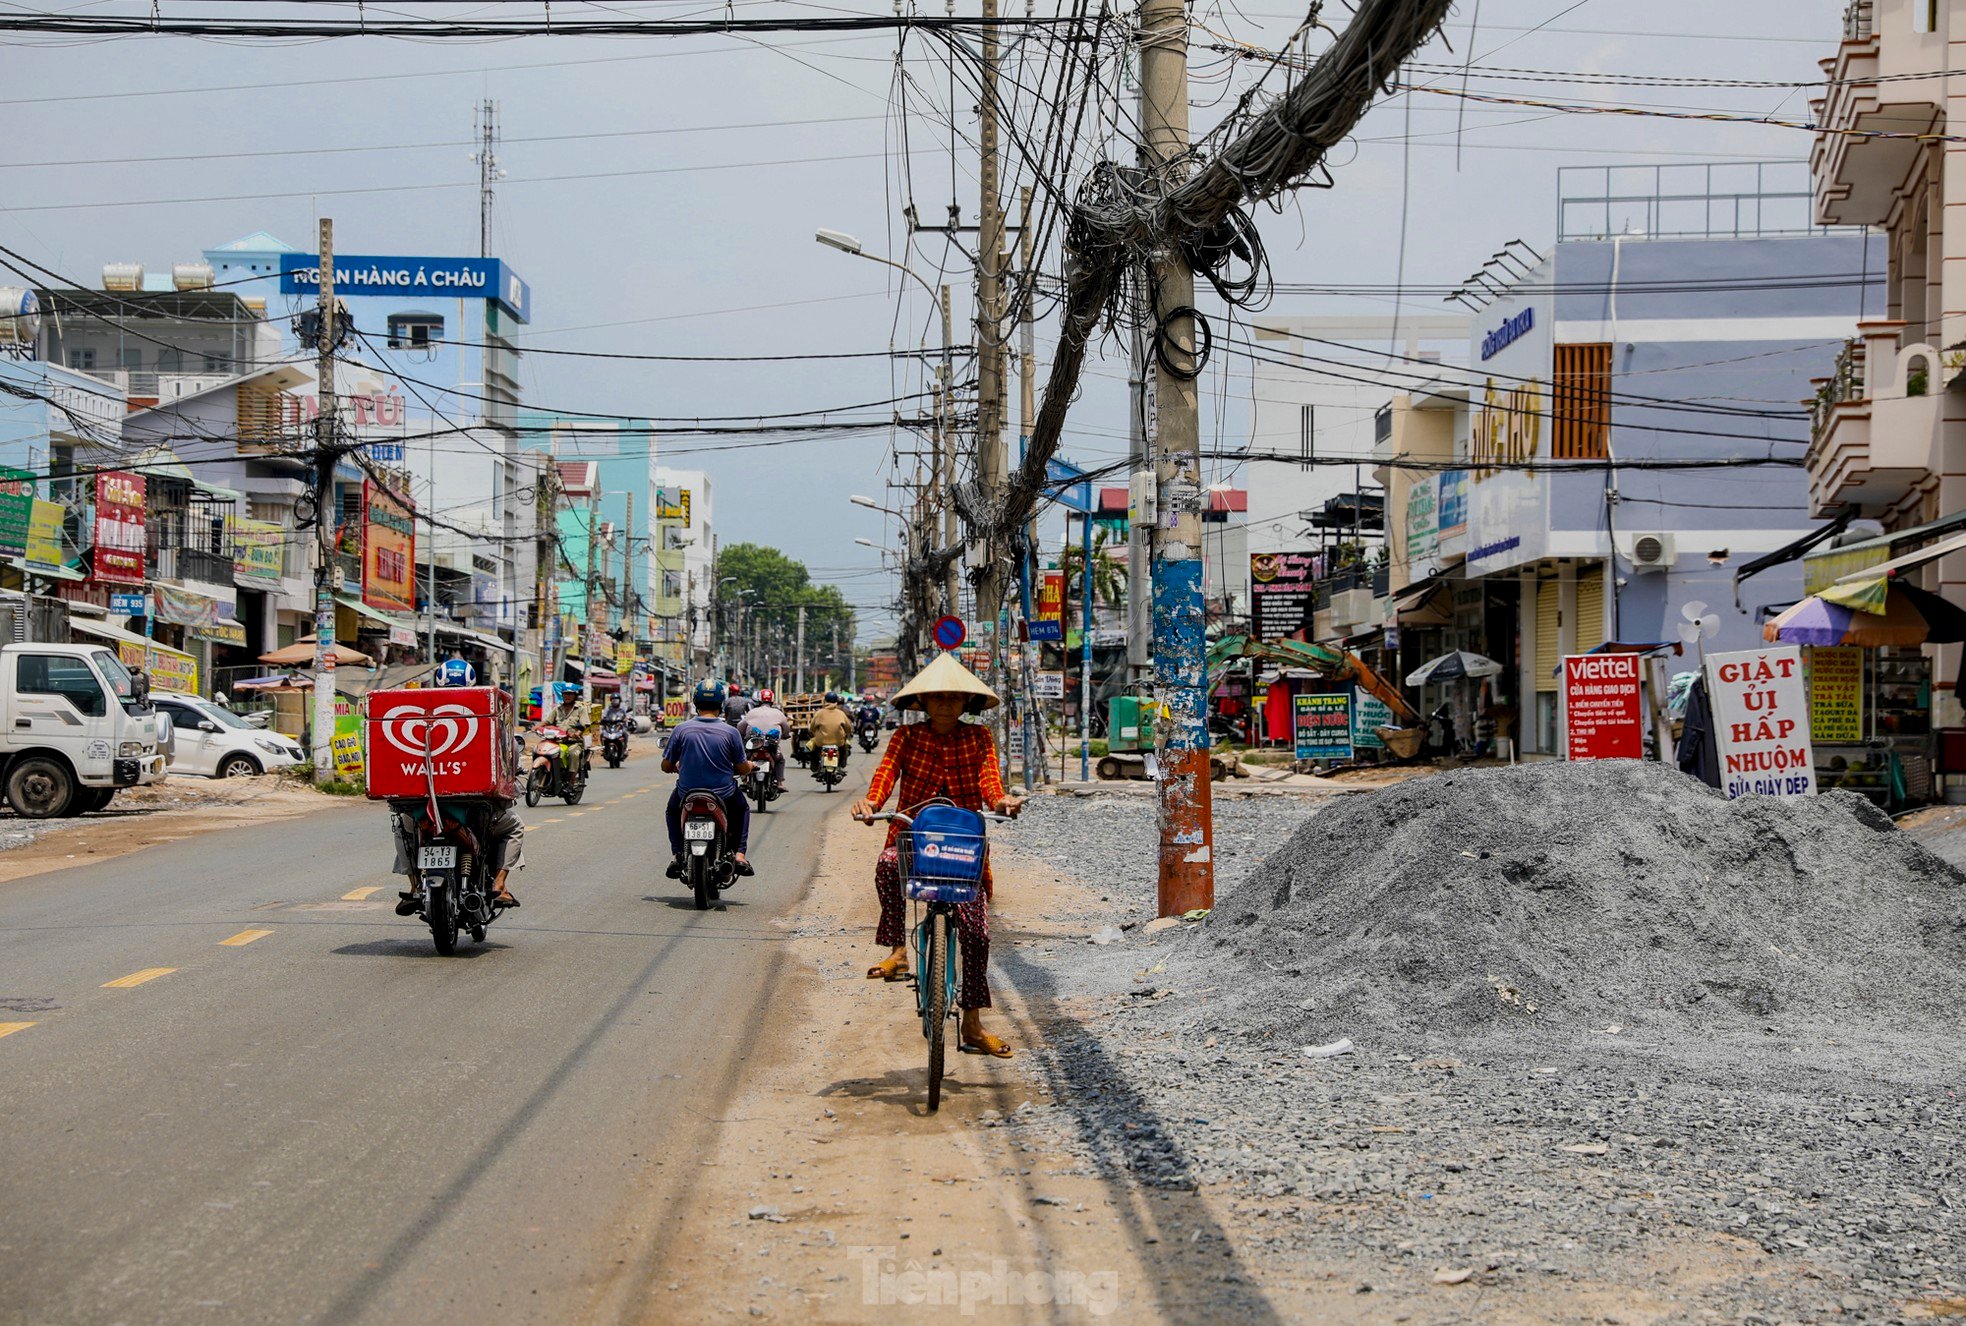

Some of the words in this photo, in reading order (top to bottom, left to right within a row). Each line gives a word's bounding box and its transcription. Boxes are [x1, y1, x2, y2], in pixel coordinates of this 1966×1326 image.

[292, 267, 350, 285] NGN
[354, 265, 410, 286] HÀNG
[414, 266, 428, 286] Á
[431, 267, 486, 287] CHÂU
[130, 599, 143, 608] 935
[1719, 655, 1795, 684] GIẶT
[1570, 682, 1584, 696] CỬA
[1584, 683, 1602, 695] HÀNG
[1603, 685, 1619, 694] GIAO
[1620, 684, 1635, 696] DỊCH
[1743, 683, 1778, 711] ỦI
[1323, 697, 1347, 705] TRANG
[1297, 711, 1321, 729] ĐIỆN
[1322, 711, 1349, 726] NƯỚC
[1731, 711, 1795, 743] HẤP
[400, 761, 462, 776] WALL'S
[1725, 745, 1807, 774] NHUỘM
[1728, 775, 1751, 800] SỬA
[1755, 774, 1782, 796] GIÀY
[1786, 772, 1809, 795] DÉP
[424, 858, 451, 867] 1865
